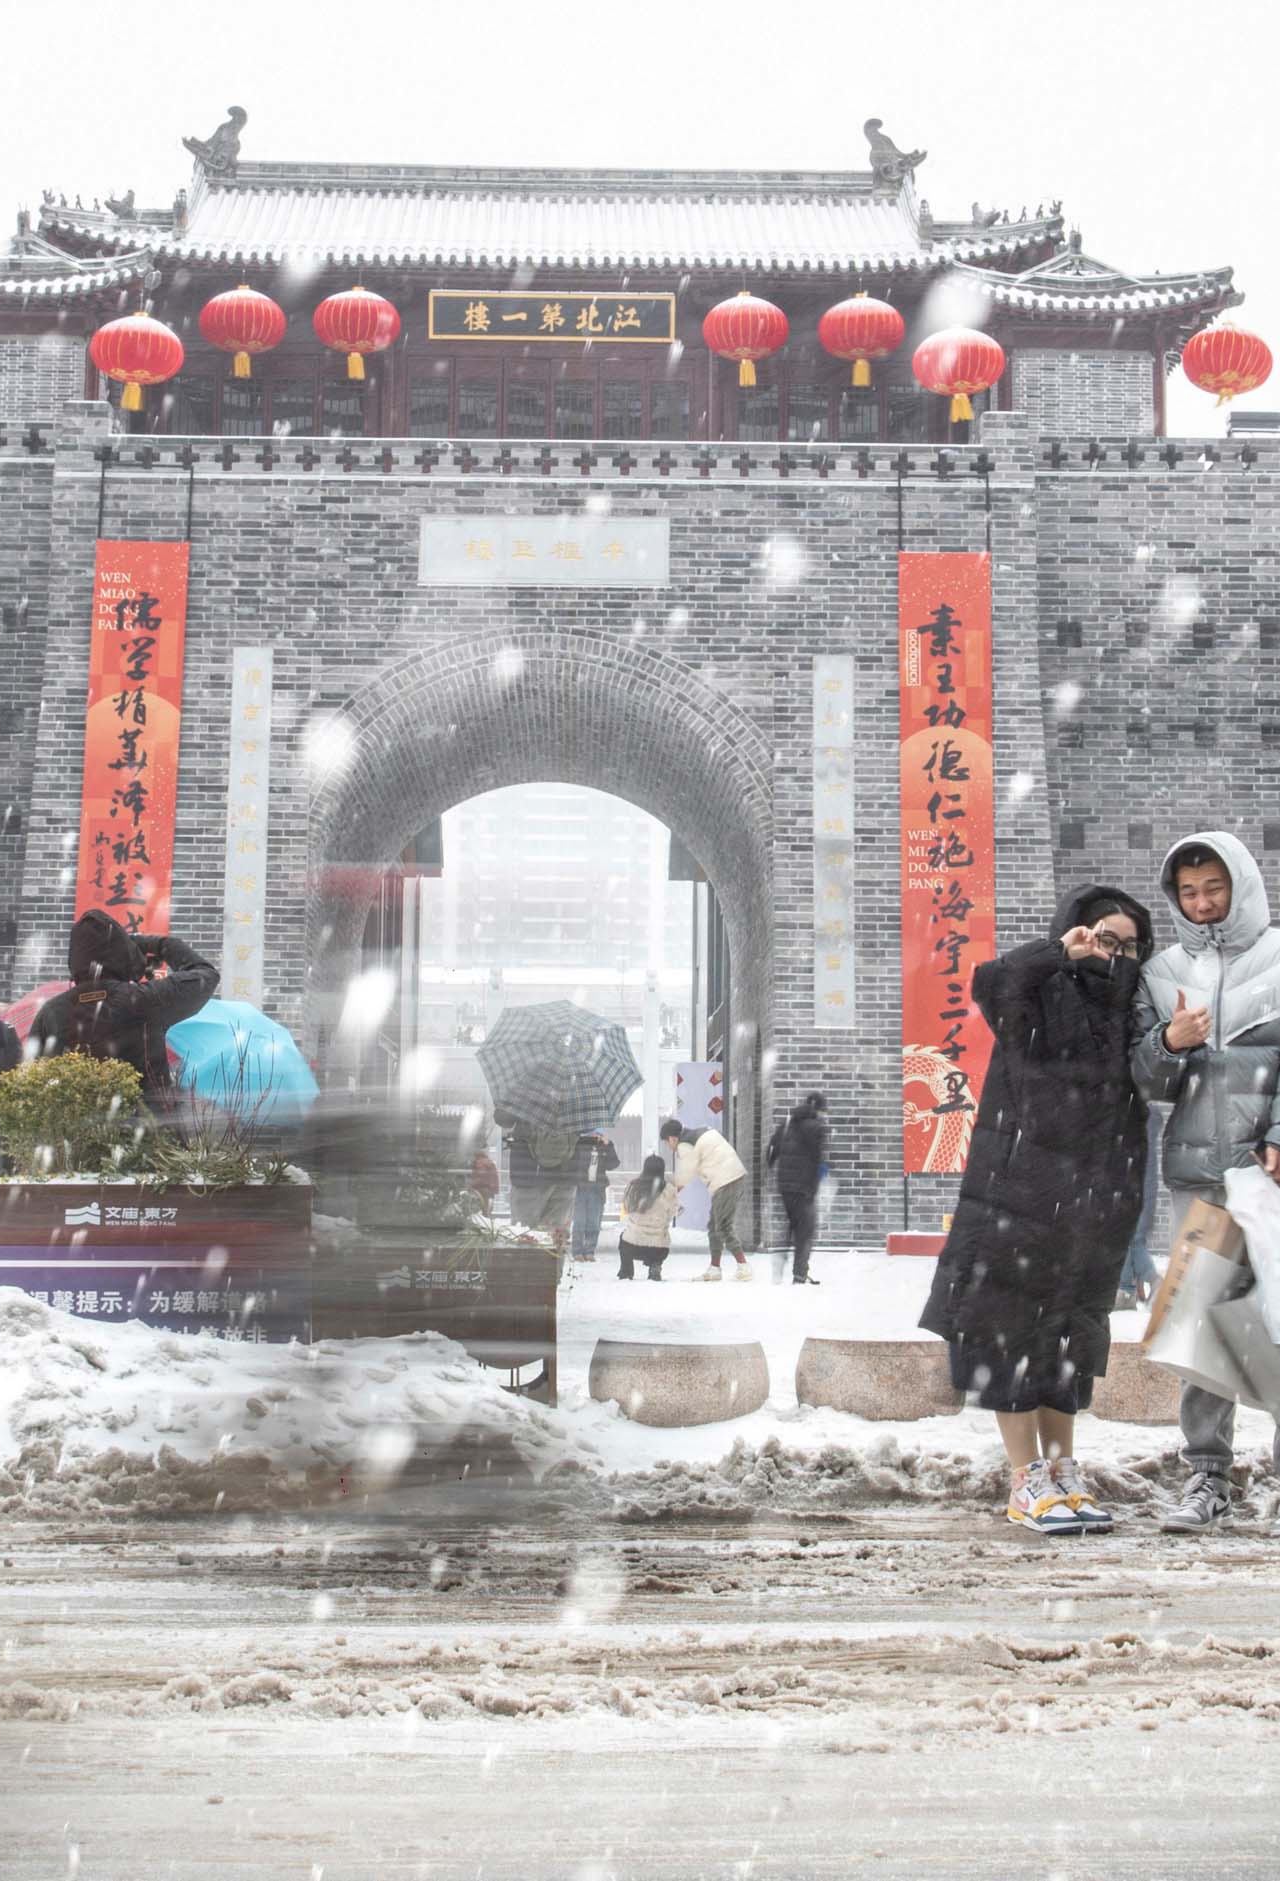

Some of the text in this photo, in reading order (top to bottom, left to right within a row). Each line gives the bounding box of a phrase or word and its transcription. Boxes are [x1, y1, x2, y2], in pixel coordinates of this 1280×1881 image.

[101, 572, 132, 584] WEN
[99, 587, 137, 599] MIAO
[907, 830, 938, 841] WEN
